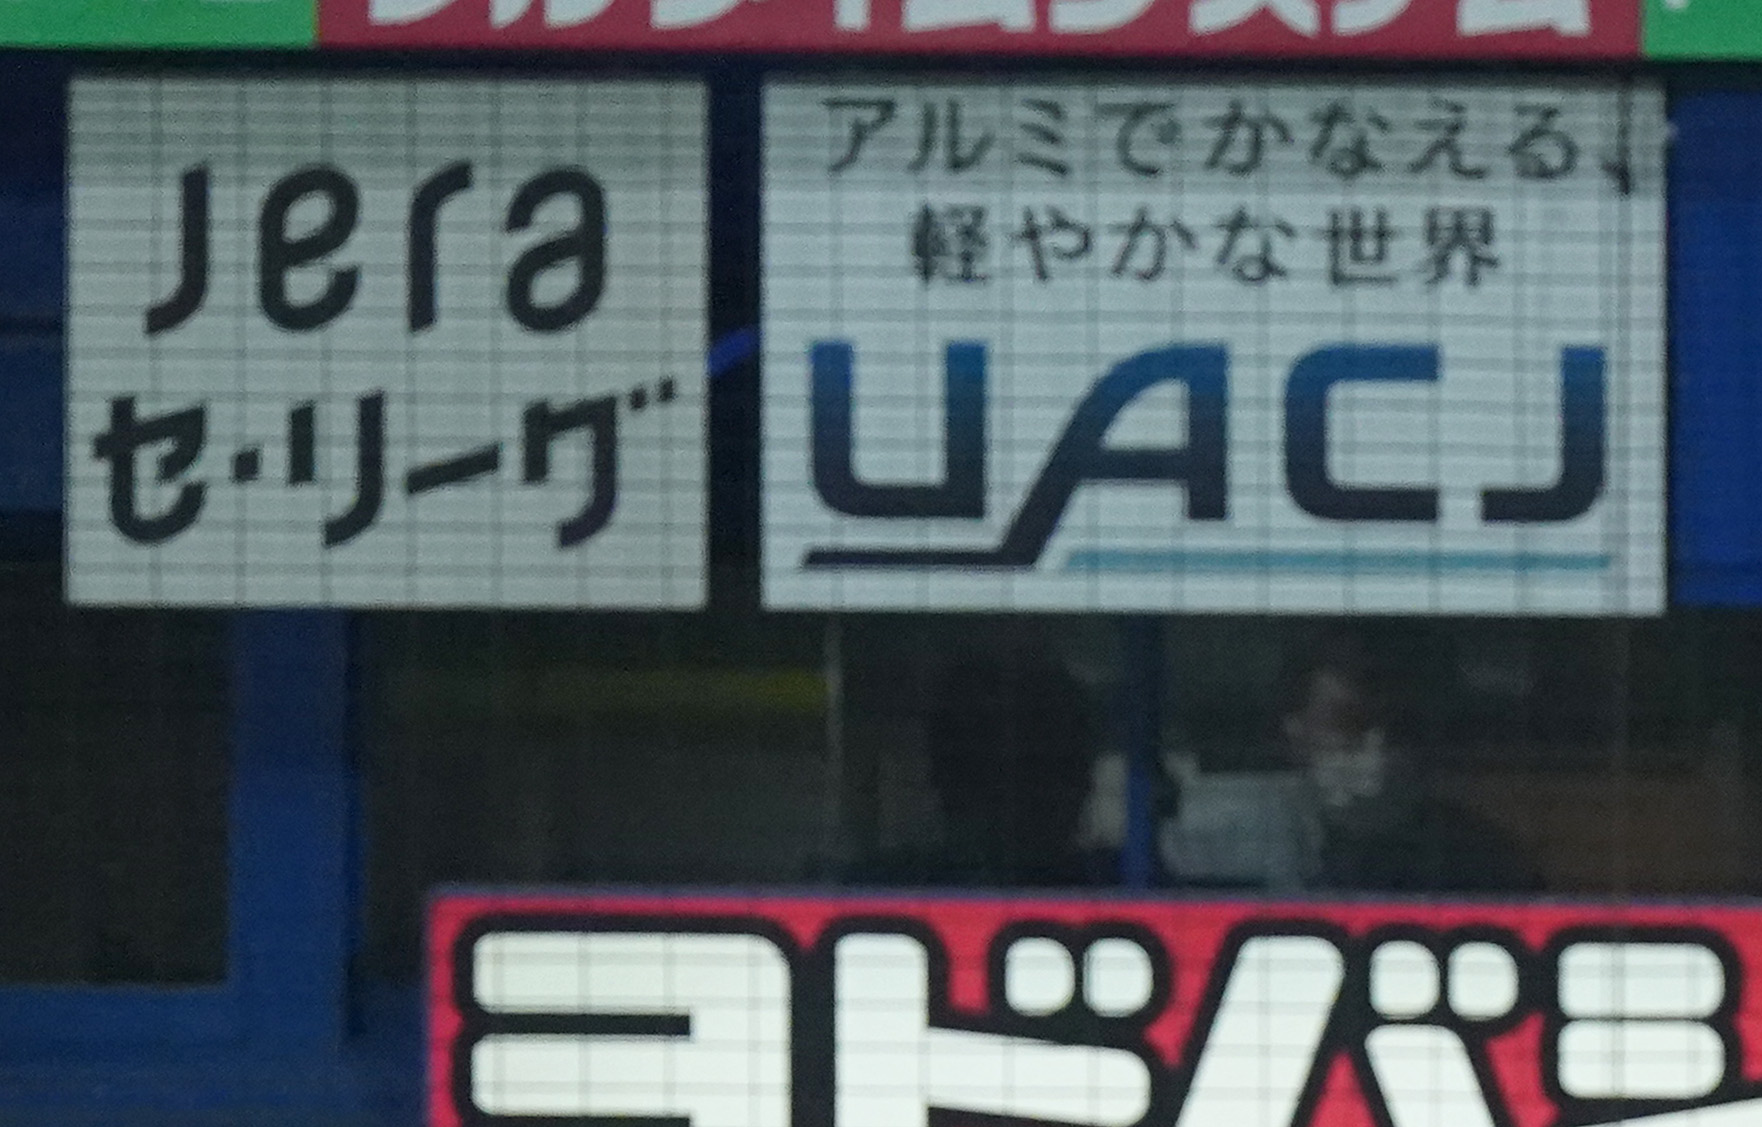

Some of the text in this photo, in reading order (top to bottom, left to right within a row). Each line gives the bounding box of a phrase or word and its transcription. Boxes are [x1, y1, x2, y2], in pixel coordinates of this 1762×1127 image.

[911, 202, 1501, 287] 軽やかな世界
[93, 376, 680, 549] セ・リーグ
[806, 341, 1605, 567] UACJ
